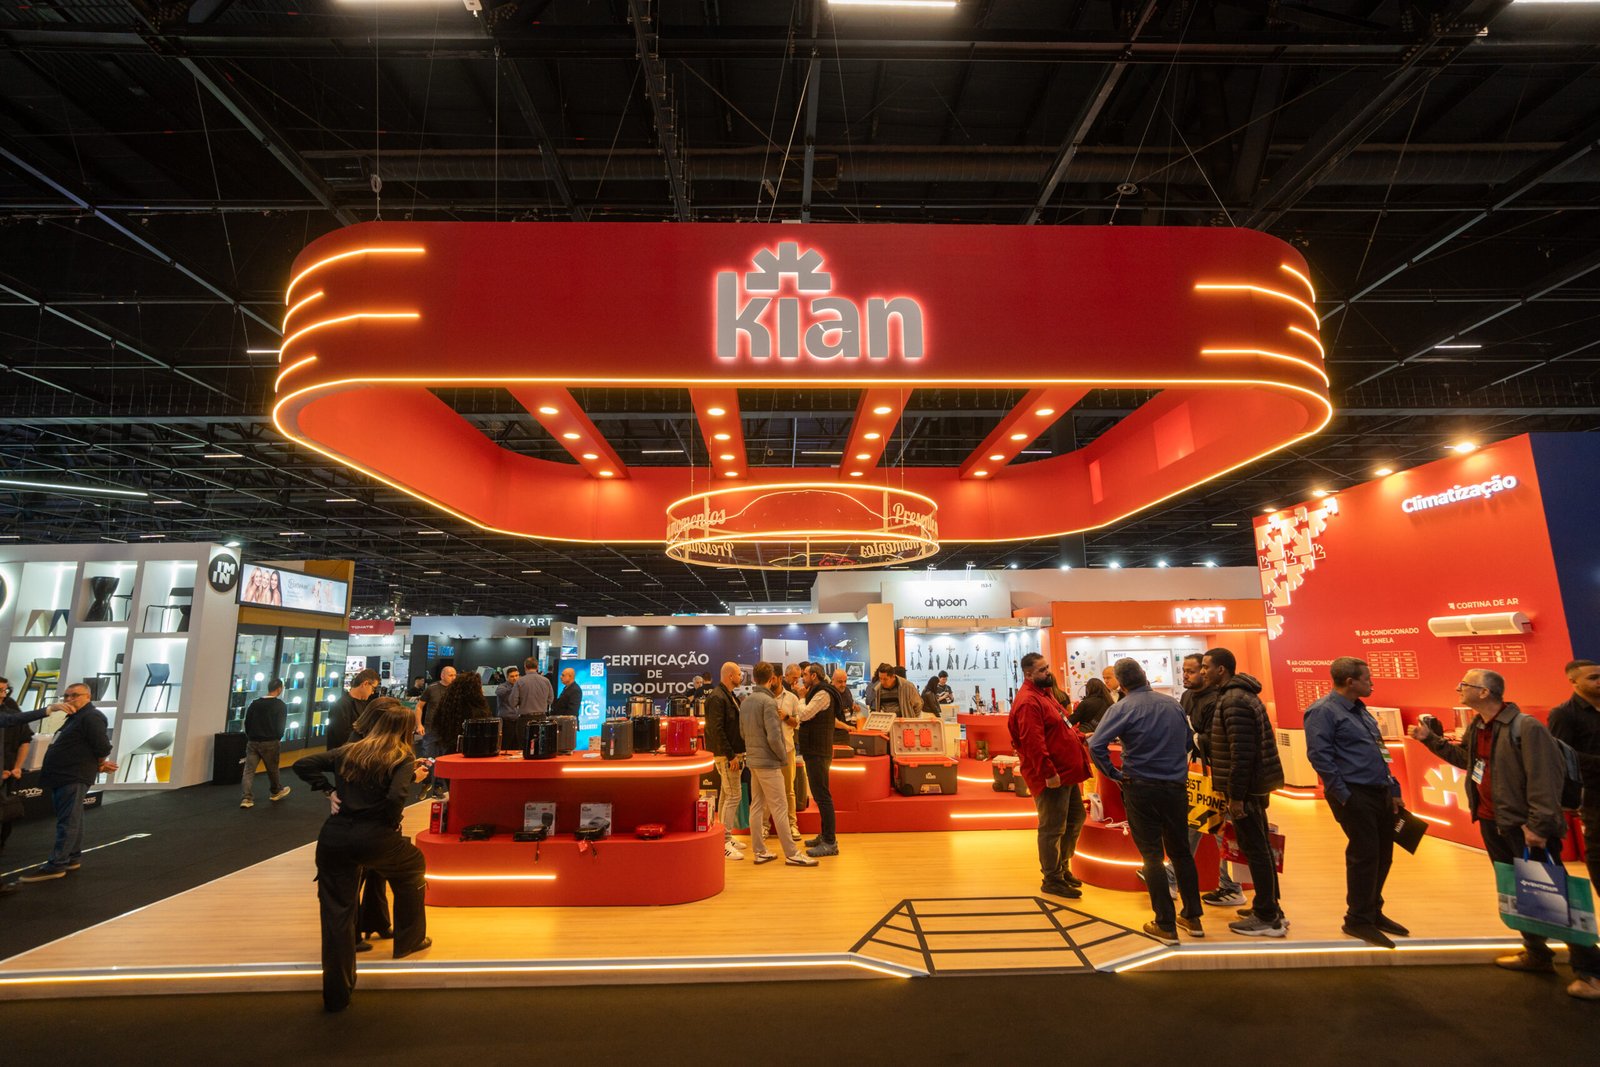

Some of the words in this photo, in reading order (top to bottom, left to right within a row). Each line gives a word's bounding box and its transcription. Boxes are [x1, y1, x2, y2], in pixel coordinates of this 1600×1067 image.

[717, 242, 923, 359] kian
[1401, 475, 1517, 513] Climatização
[212, 571, 231, 585] IN
[924, 597, 968, 609] ahpoon
[1456, 601, 1491, 610] CORTINA
[1493, 599, 1505, 607] DE
[1507, 597, 1519, 605] AR
[1174, 606, 1226, 624] MOFT
[1361, 627, 1420, 637] AR-CONDICIONADO
[602, 651, 710, 668] CERTIFICAÇÃO
[647, 669, 663, 679] DE
[1196, 793, 1226, 812] PHONE
